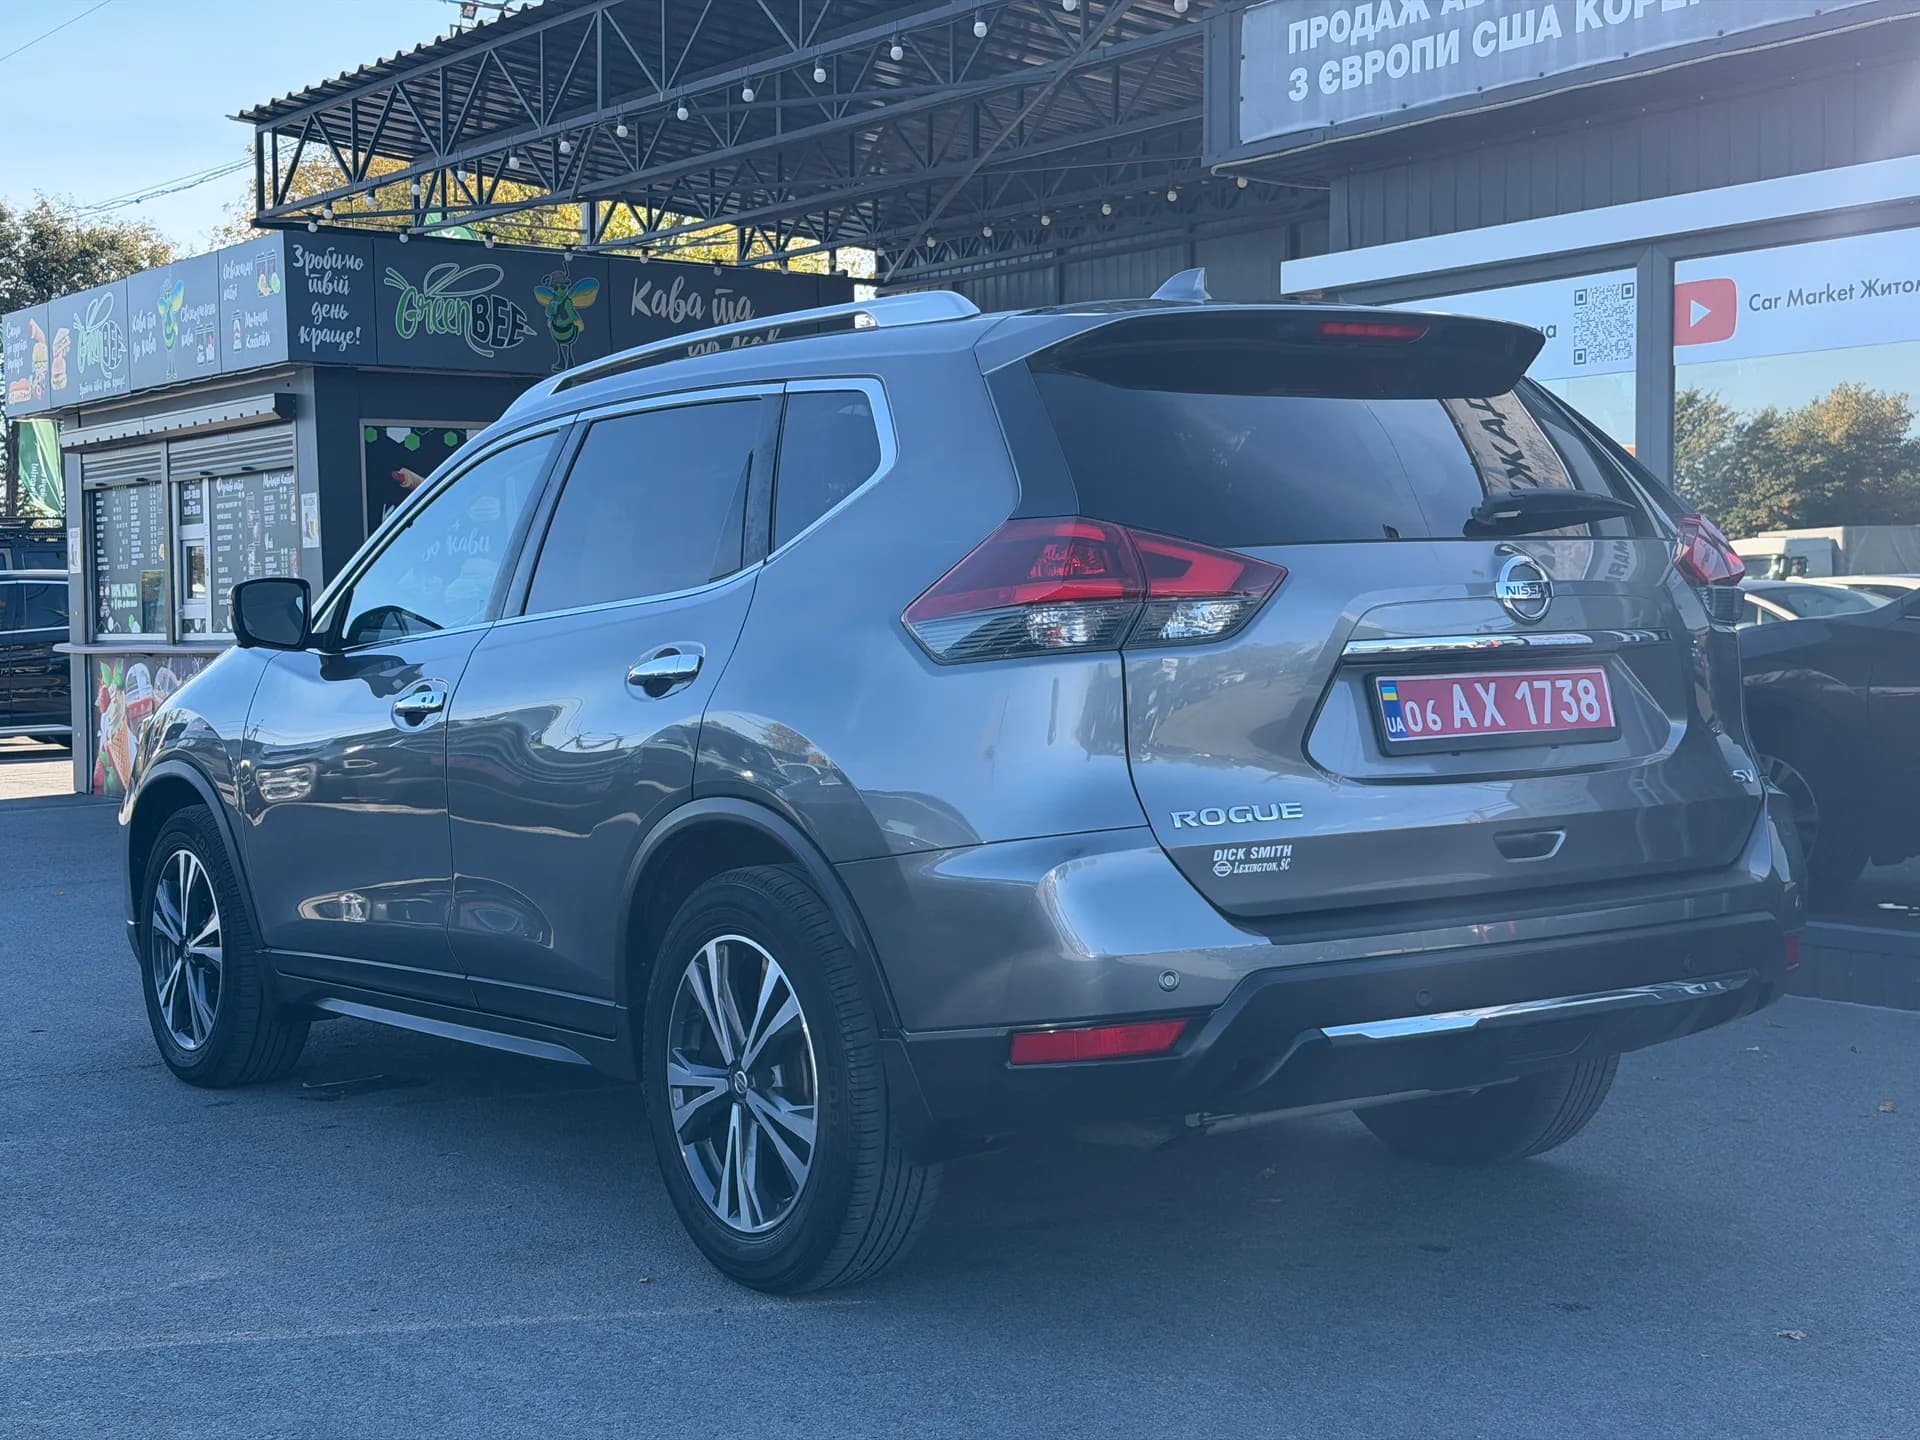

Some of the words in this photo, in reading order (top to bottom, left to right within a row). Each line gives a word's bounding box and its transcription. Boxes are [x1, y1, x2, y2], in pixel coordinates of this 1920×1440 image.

[1288, 0, 1432, 54] ПРОДАЖ
[1288, 67, 1309, 102] З
[1318, 29, 1460, 95] ЄВРОПИ
[1472, 4, 1562, 57] США
[293, 244, 364, 276] Зробимо
[308, 270, 351, 296] твій
[631, 275, 706, 323] Кава
[712, 288, 756, 324] та
[1750, 293, 1781, 312] Car
[1786, 283, 1855, 308] Market
[311, 301, 349, 325] день
[298, 326, 361, 352] краще!
[1504, 584, 1552, 597] NISSAN
[1405, 700, 1442, 733] 06
[1515, 678, 1601, 725] 1738
[1386, 717, 1407, 733] UA
[1170, 802, 1304, 829] ROGUE
[1213, 848, 1247, 862] DICK
[1250, 845, 1292, 858] SMITH
[1279, 858, 1291, 871] SC
